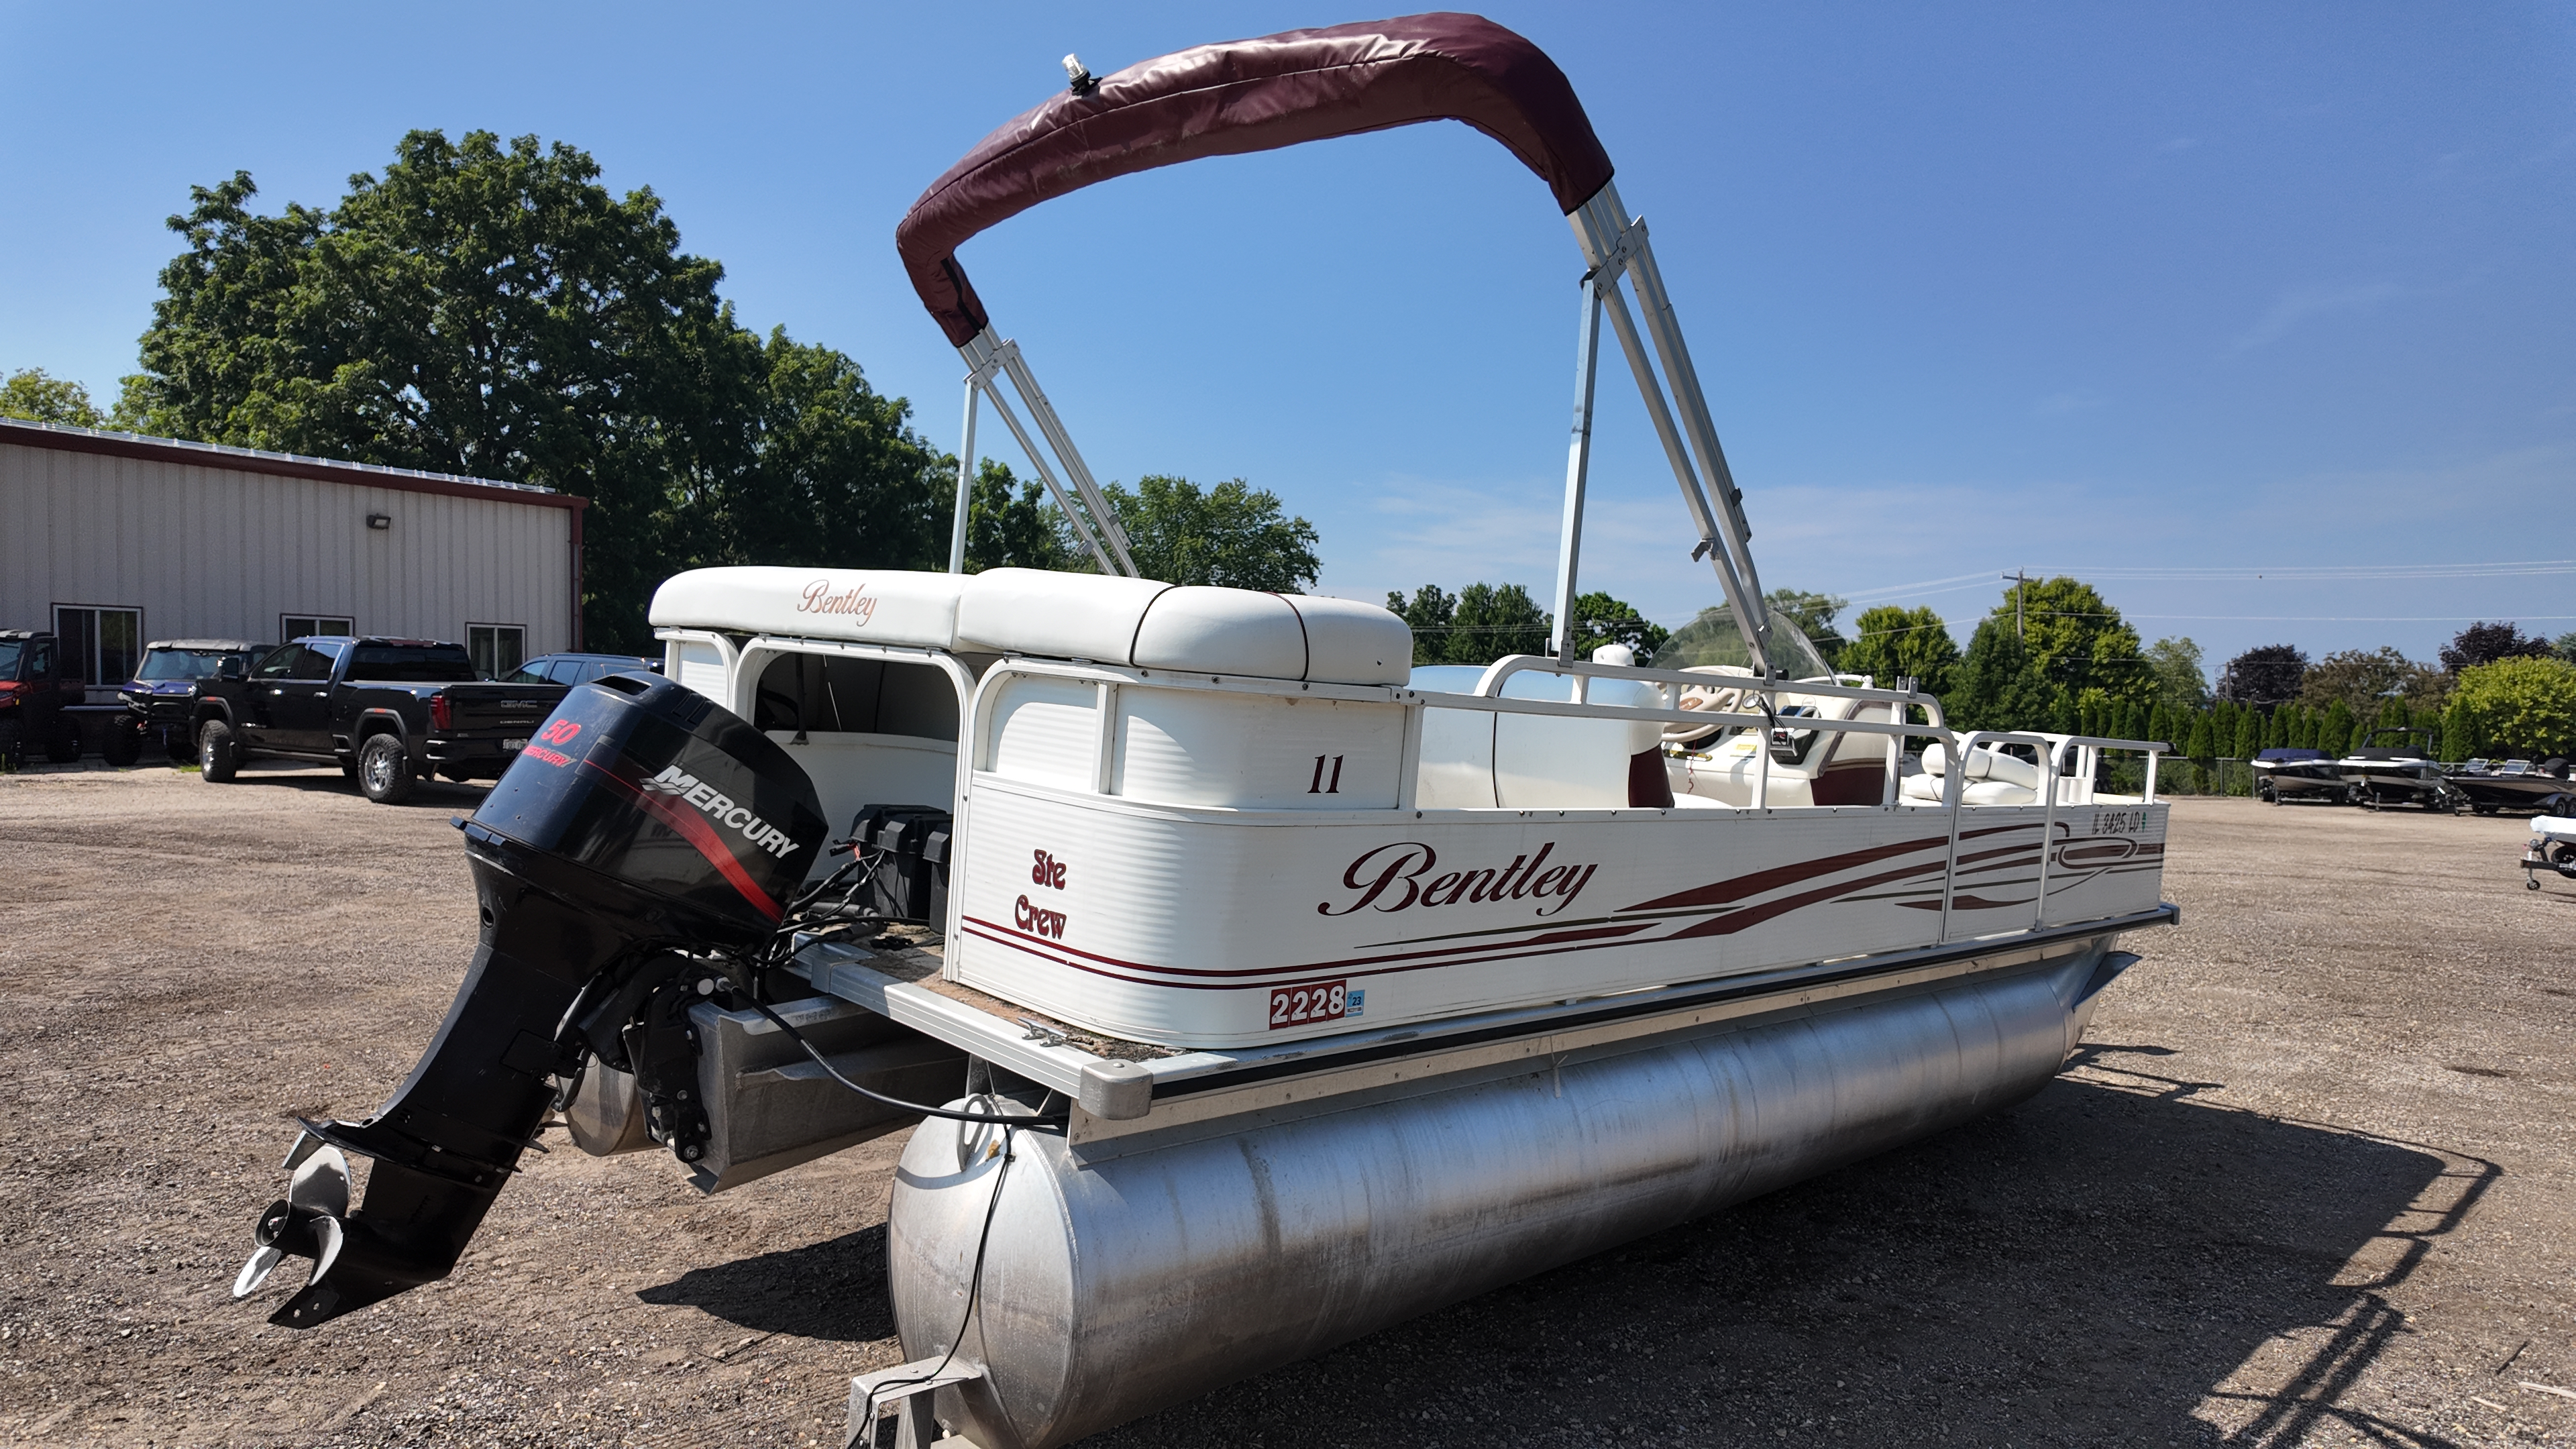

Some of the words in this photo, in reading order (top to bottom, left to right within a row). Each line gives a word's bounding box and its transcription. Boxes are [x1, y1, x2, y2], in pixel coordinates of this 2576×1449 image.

[797, 579, 877, 627] Bentley
[500, 700, 537, 708] GMC
[541, 719, 582, 746] 50
[1307, 754, 1344, 794] 11
[639, 765, 800, 859] MERCURY
[2102, 812, 2127, 834] 3425
[2129, 811, 2140, 833] LD
[1032, 849, 1067, 890] Ste
[1318, 842, 1598, 916] Bentley
[1015, 894, 1067, 940] Crew
[1271, 985, 1344, 1024] 2228
[1352, 996, 1362, 1006] 23
